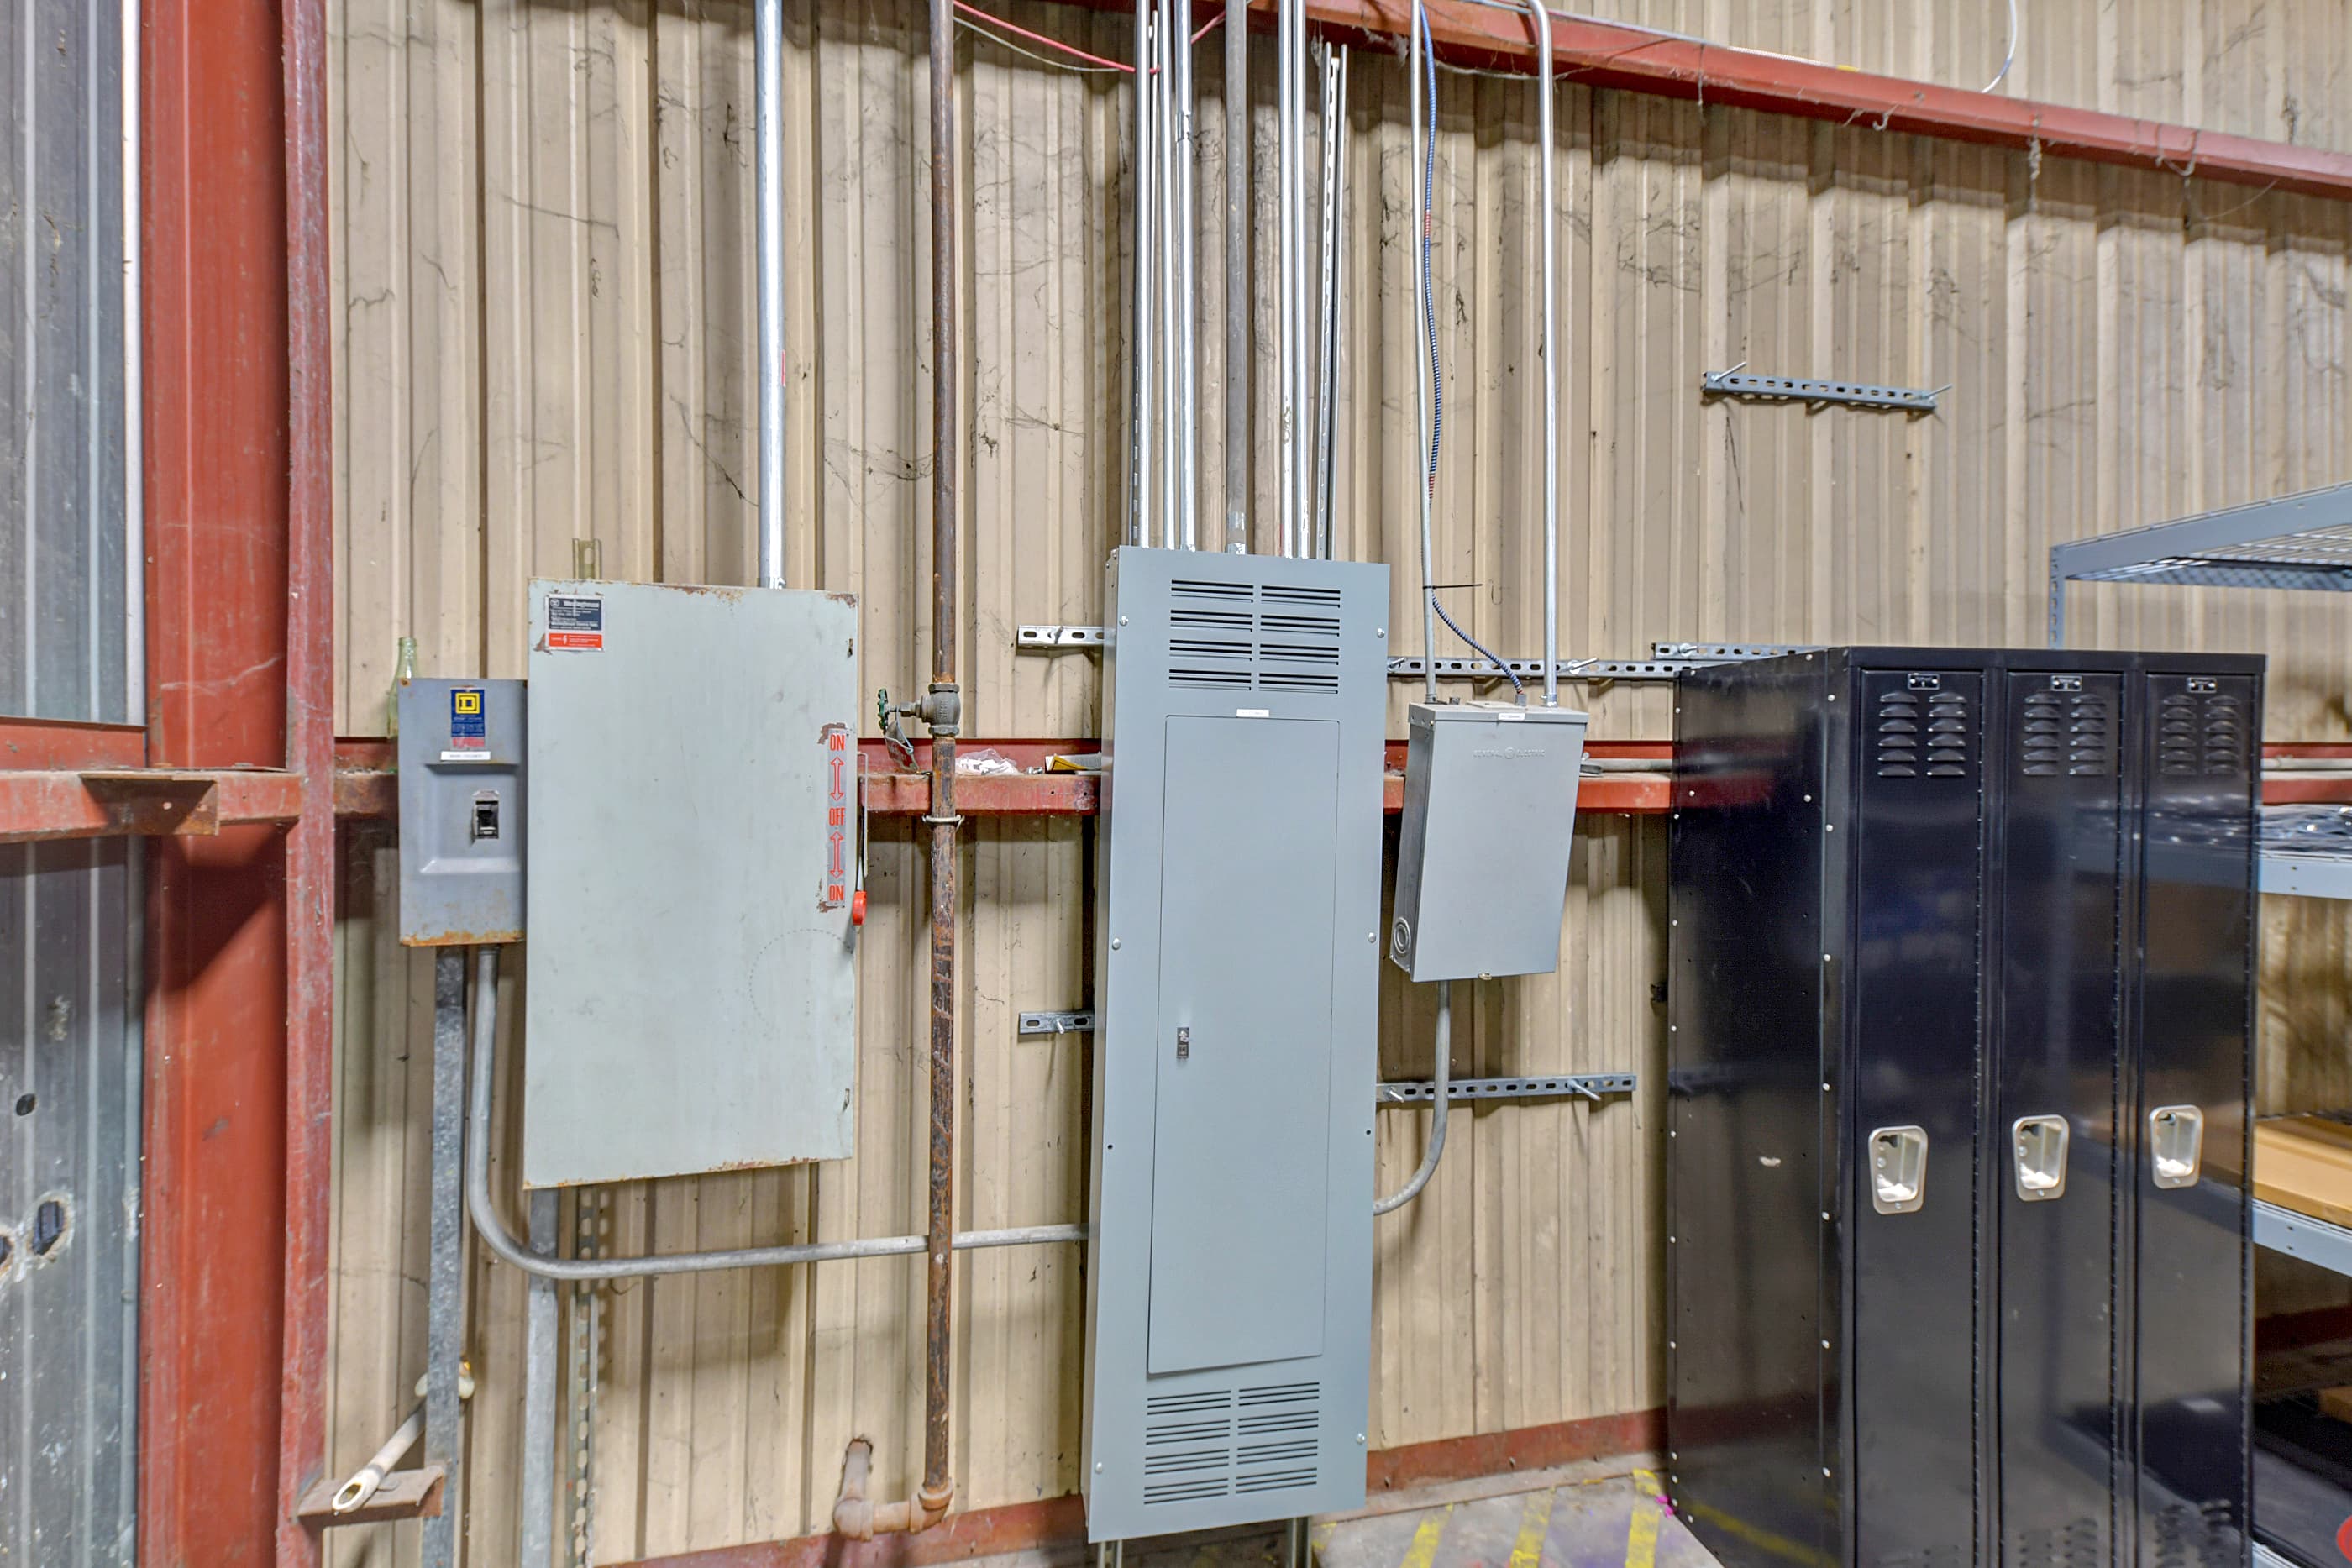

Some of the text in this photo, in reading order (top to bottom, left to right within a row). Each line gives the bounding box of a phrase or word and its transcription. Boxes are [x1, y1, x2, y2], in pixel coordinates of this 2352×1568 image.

[830, 734, 845, 751] ON
[828, 807, 845, 826] OFF
[828, 885, 844, 902] ON
